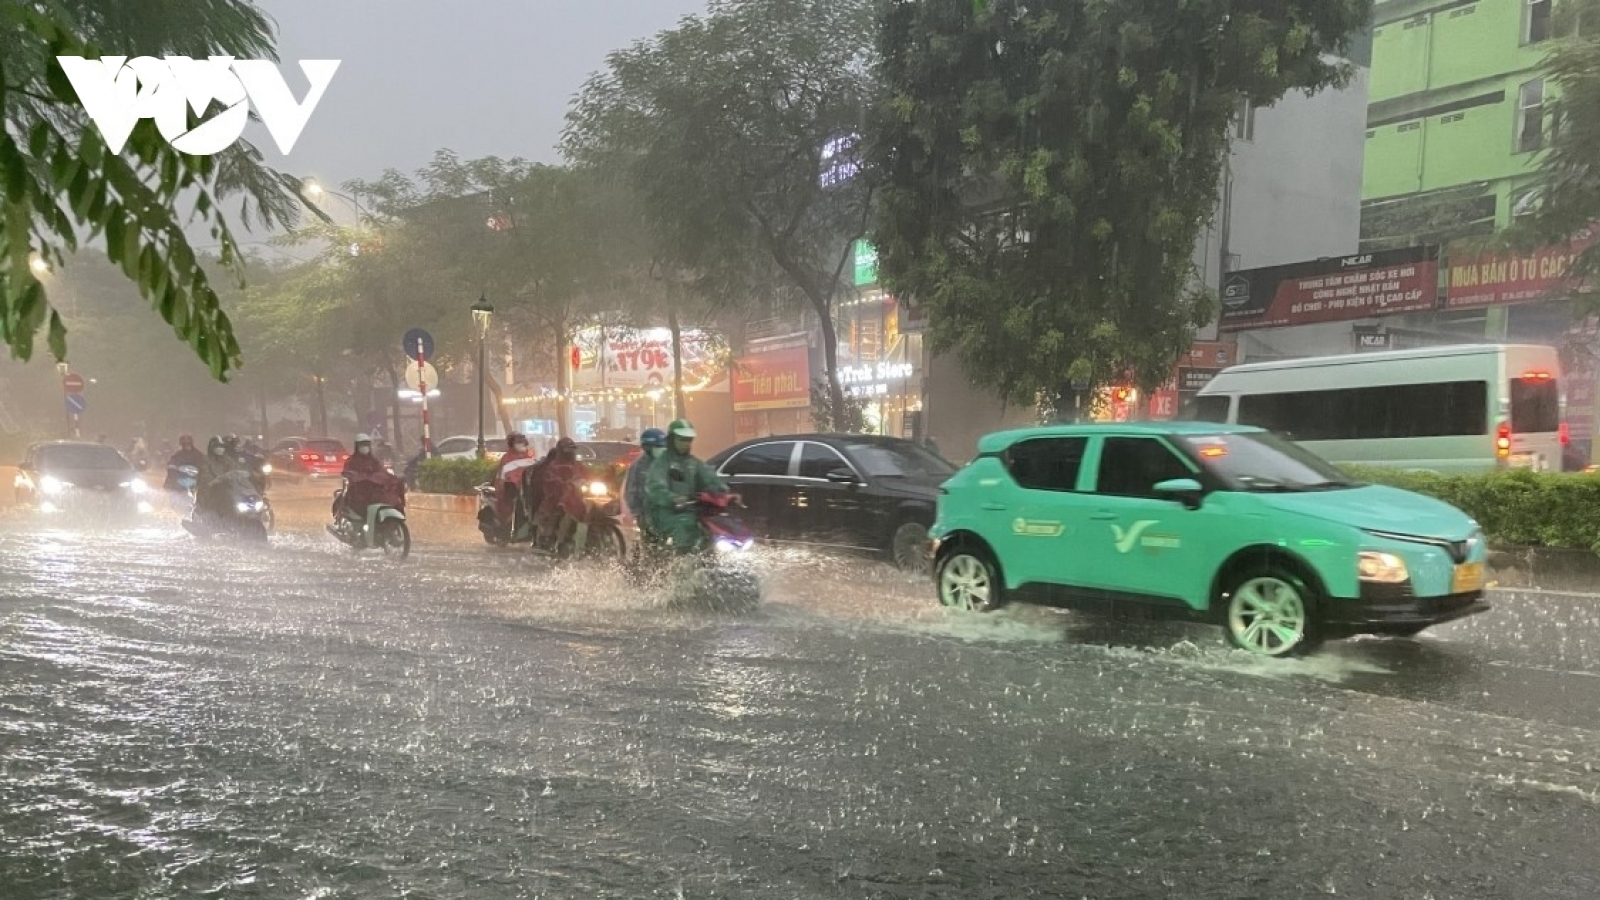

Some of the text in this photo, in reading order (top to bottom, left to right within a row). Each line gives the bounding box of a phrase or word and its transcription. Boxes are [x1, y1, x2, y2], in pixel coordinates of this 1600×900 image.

[1299, 267, 1415, 291] TRUNG TÂM CHĂM SÓC XE HƠI
[1452, 265, 1478, 287] MUA
[1481, 257, 1506, 285] BÁN
[1510, 256, 1518, 281] Ô
[1522, 254, 1536, 280] TÔ
[1303, 300, 1322, 312] CHƠI
[1328, 298, 1344, 310] PHỤ
[1346, 296, 1365, 308] KIỆN
[1367, 294, 1372, 304] Ô
[1375, 293, 1385, 304] TÔ
[1387, 292, 1403, 302] CAO
[1405, 289, 1423, 300] CẤP
[1313, 289, 1334, 299] CÔNG
[1336, 286, 1357, 298] NGHỆ
[877, 361, 913, 379] Store
[1157, 397, 1171, 415] XE
